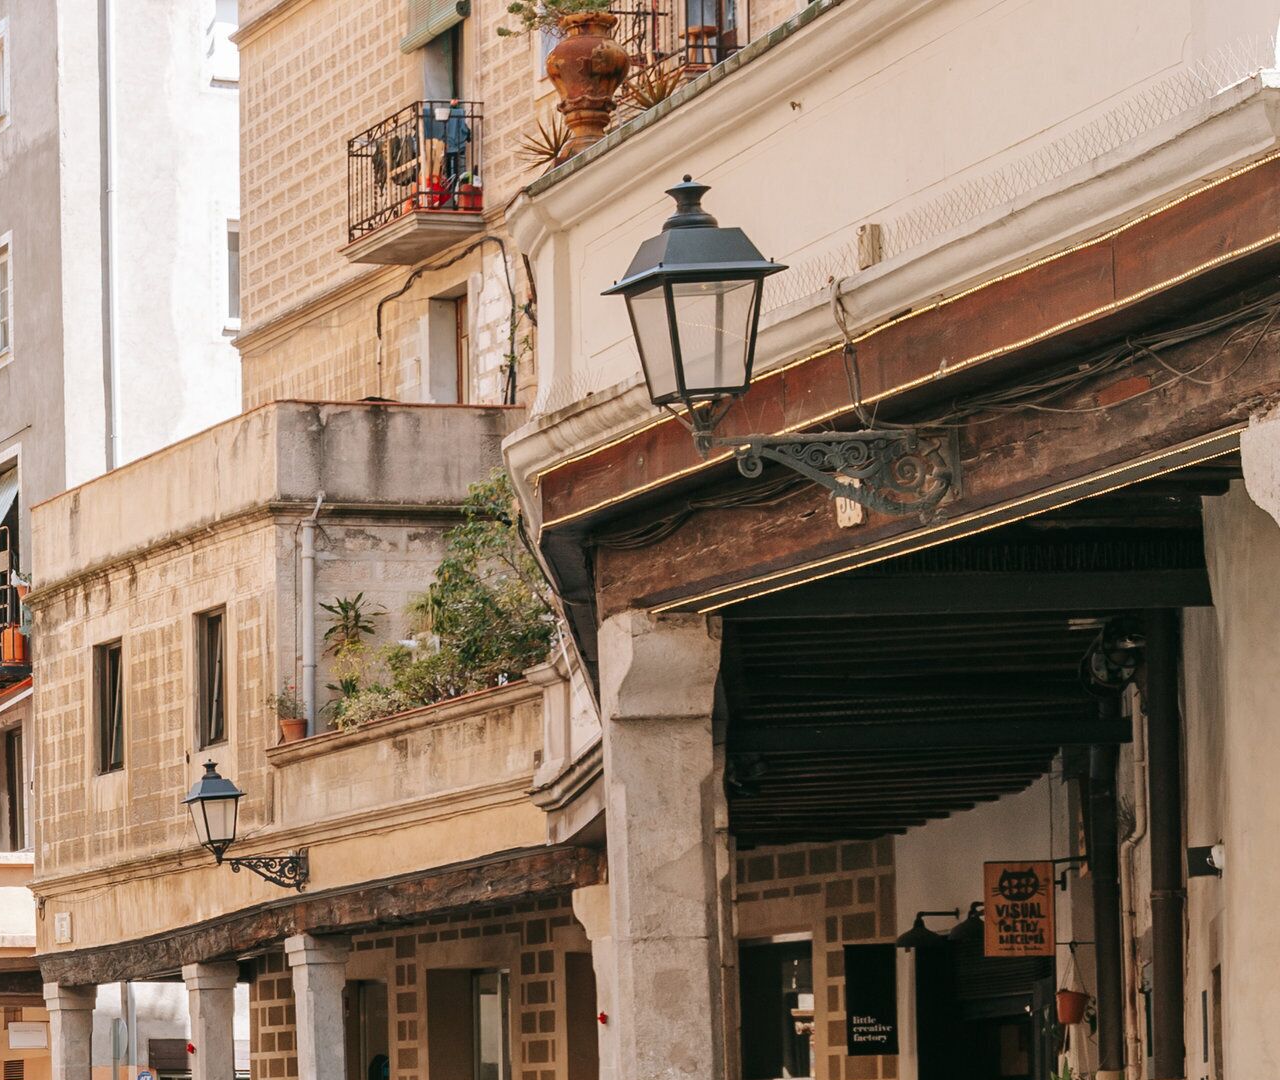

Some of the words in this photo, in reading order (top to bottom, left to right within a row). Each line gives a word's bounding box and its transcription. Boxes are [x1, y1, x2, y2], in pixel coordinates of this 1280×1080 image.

[995, 902, 1045, 919] VISUAL
[852, 1016, 877, 1025] little
[853, 1023, 893, 1033] creative
[853, 1033, 887, 1044] factory
